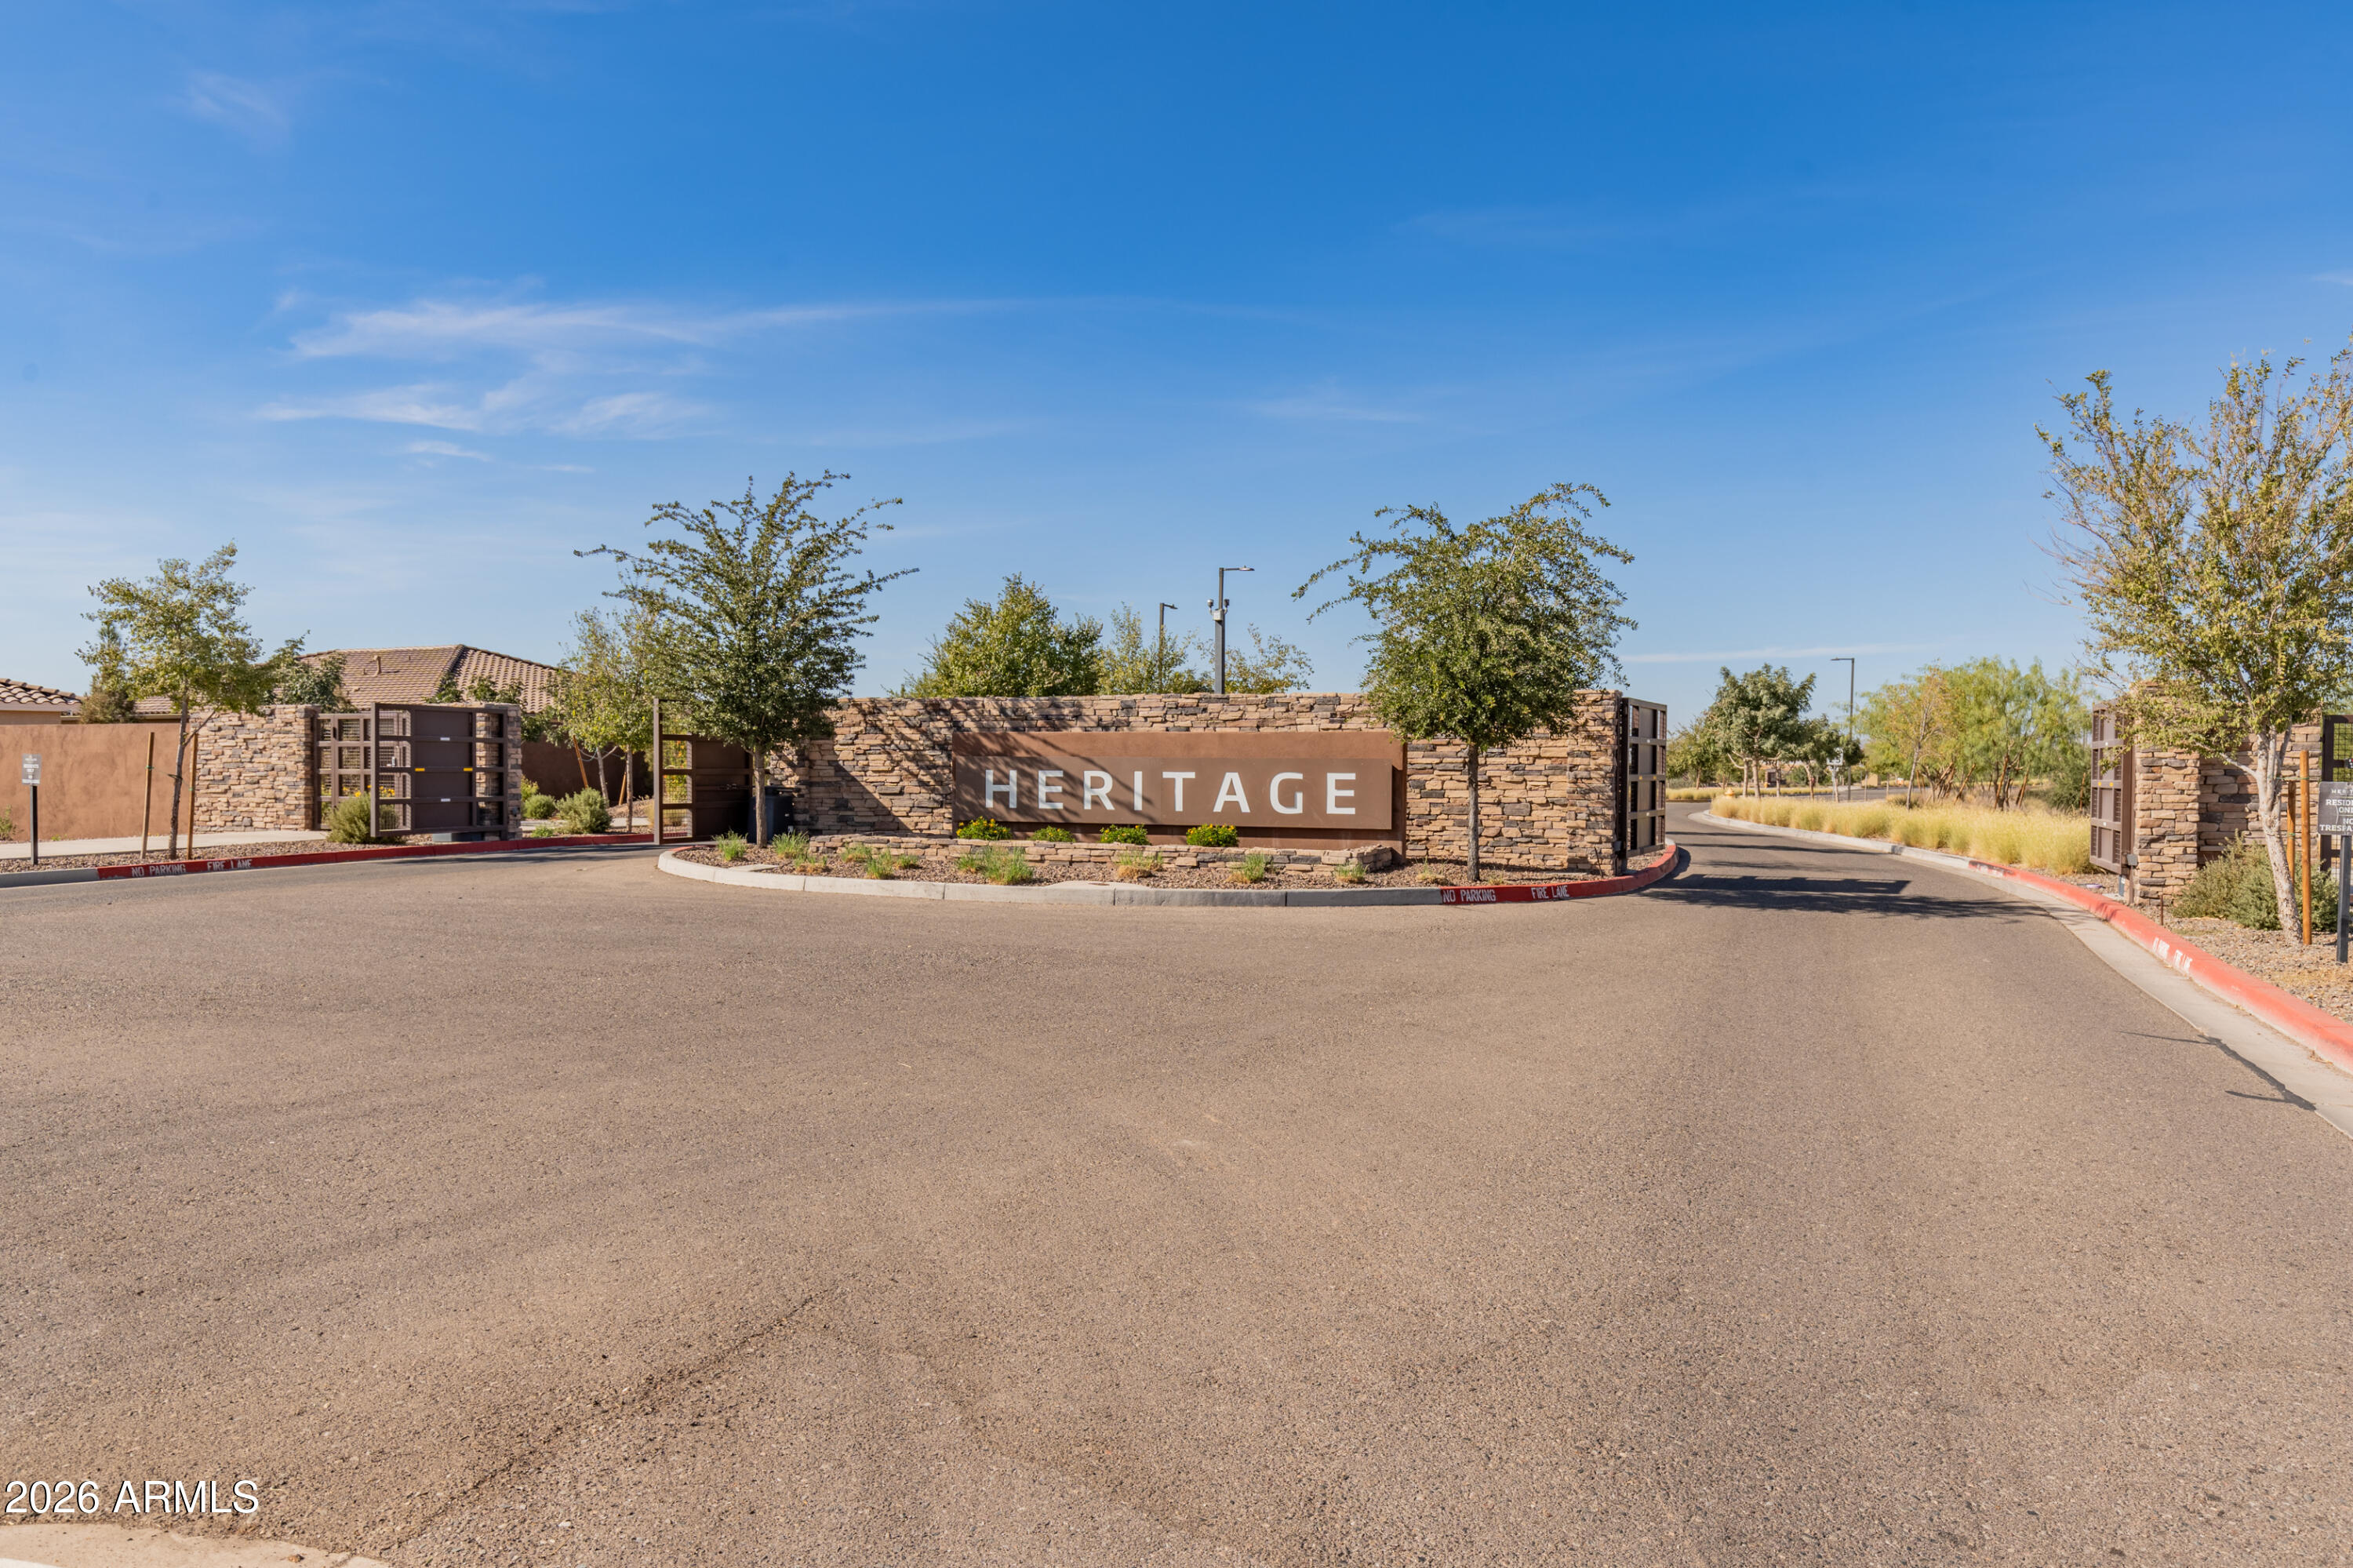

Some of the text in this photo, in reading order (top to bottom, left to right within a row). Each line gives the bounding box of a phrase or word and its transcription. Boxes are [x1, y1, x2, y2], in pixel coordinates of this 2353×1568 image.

[984, 769, 1357, 814] HERITAGE
[131, 859, 253, 877] NO PARKING FIRE LANE
[1442, 885, 1569, 902] NO PARKING FIRE LANE
